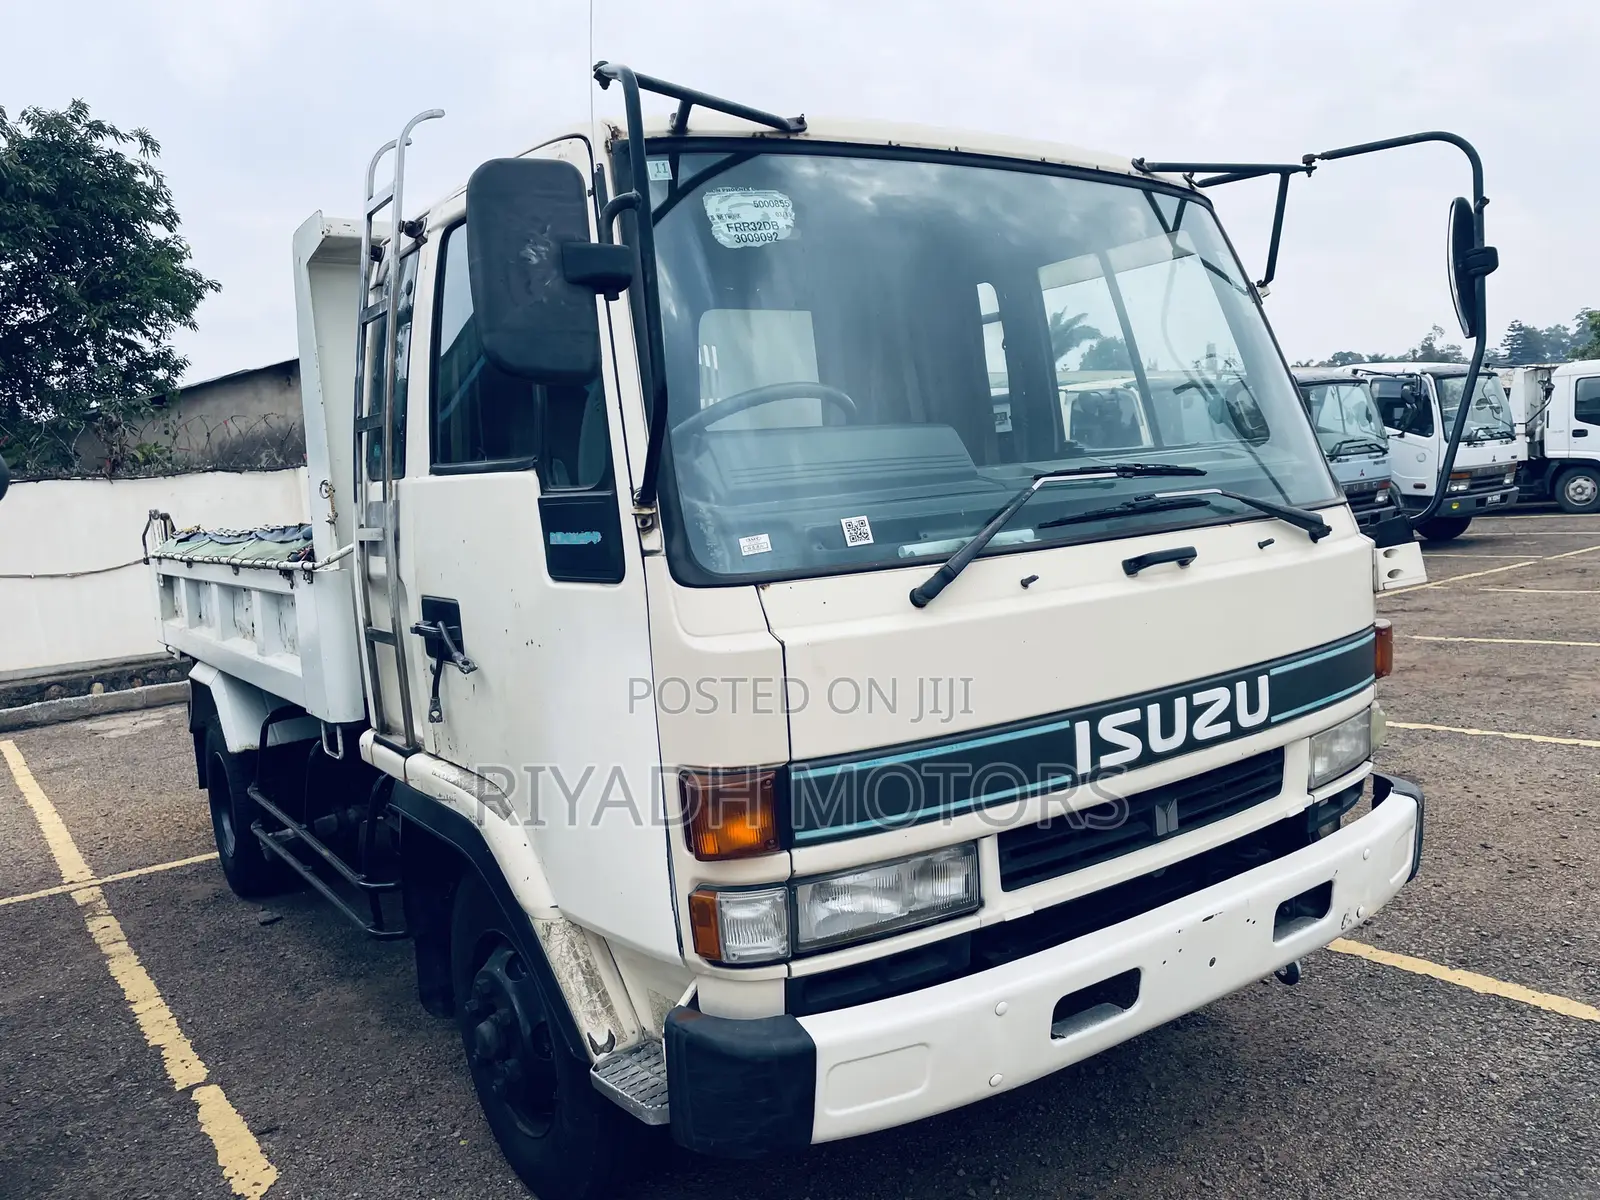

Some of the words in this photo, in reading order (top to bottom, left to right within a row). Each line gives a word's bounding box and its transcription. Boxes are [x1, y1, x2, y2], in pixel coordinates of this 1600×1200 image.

[655, 162, 668, 174] 11
[753, 199, 790, 209] 5000855
[726, 220, 780, 233] FRR32DB
[734, 231, 779, 244] 3009092
[1075, 674, 1270, 775] ISUZU
